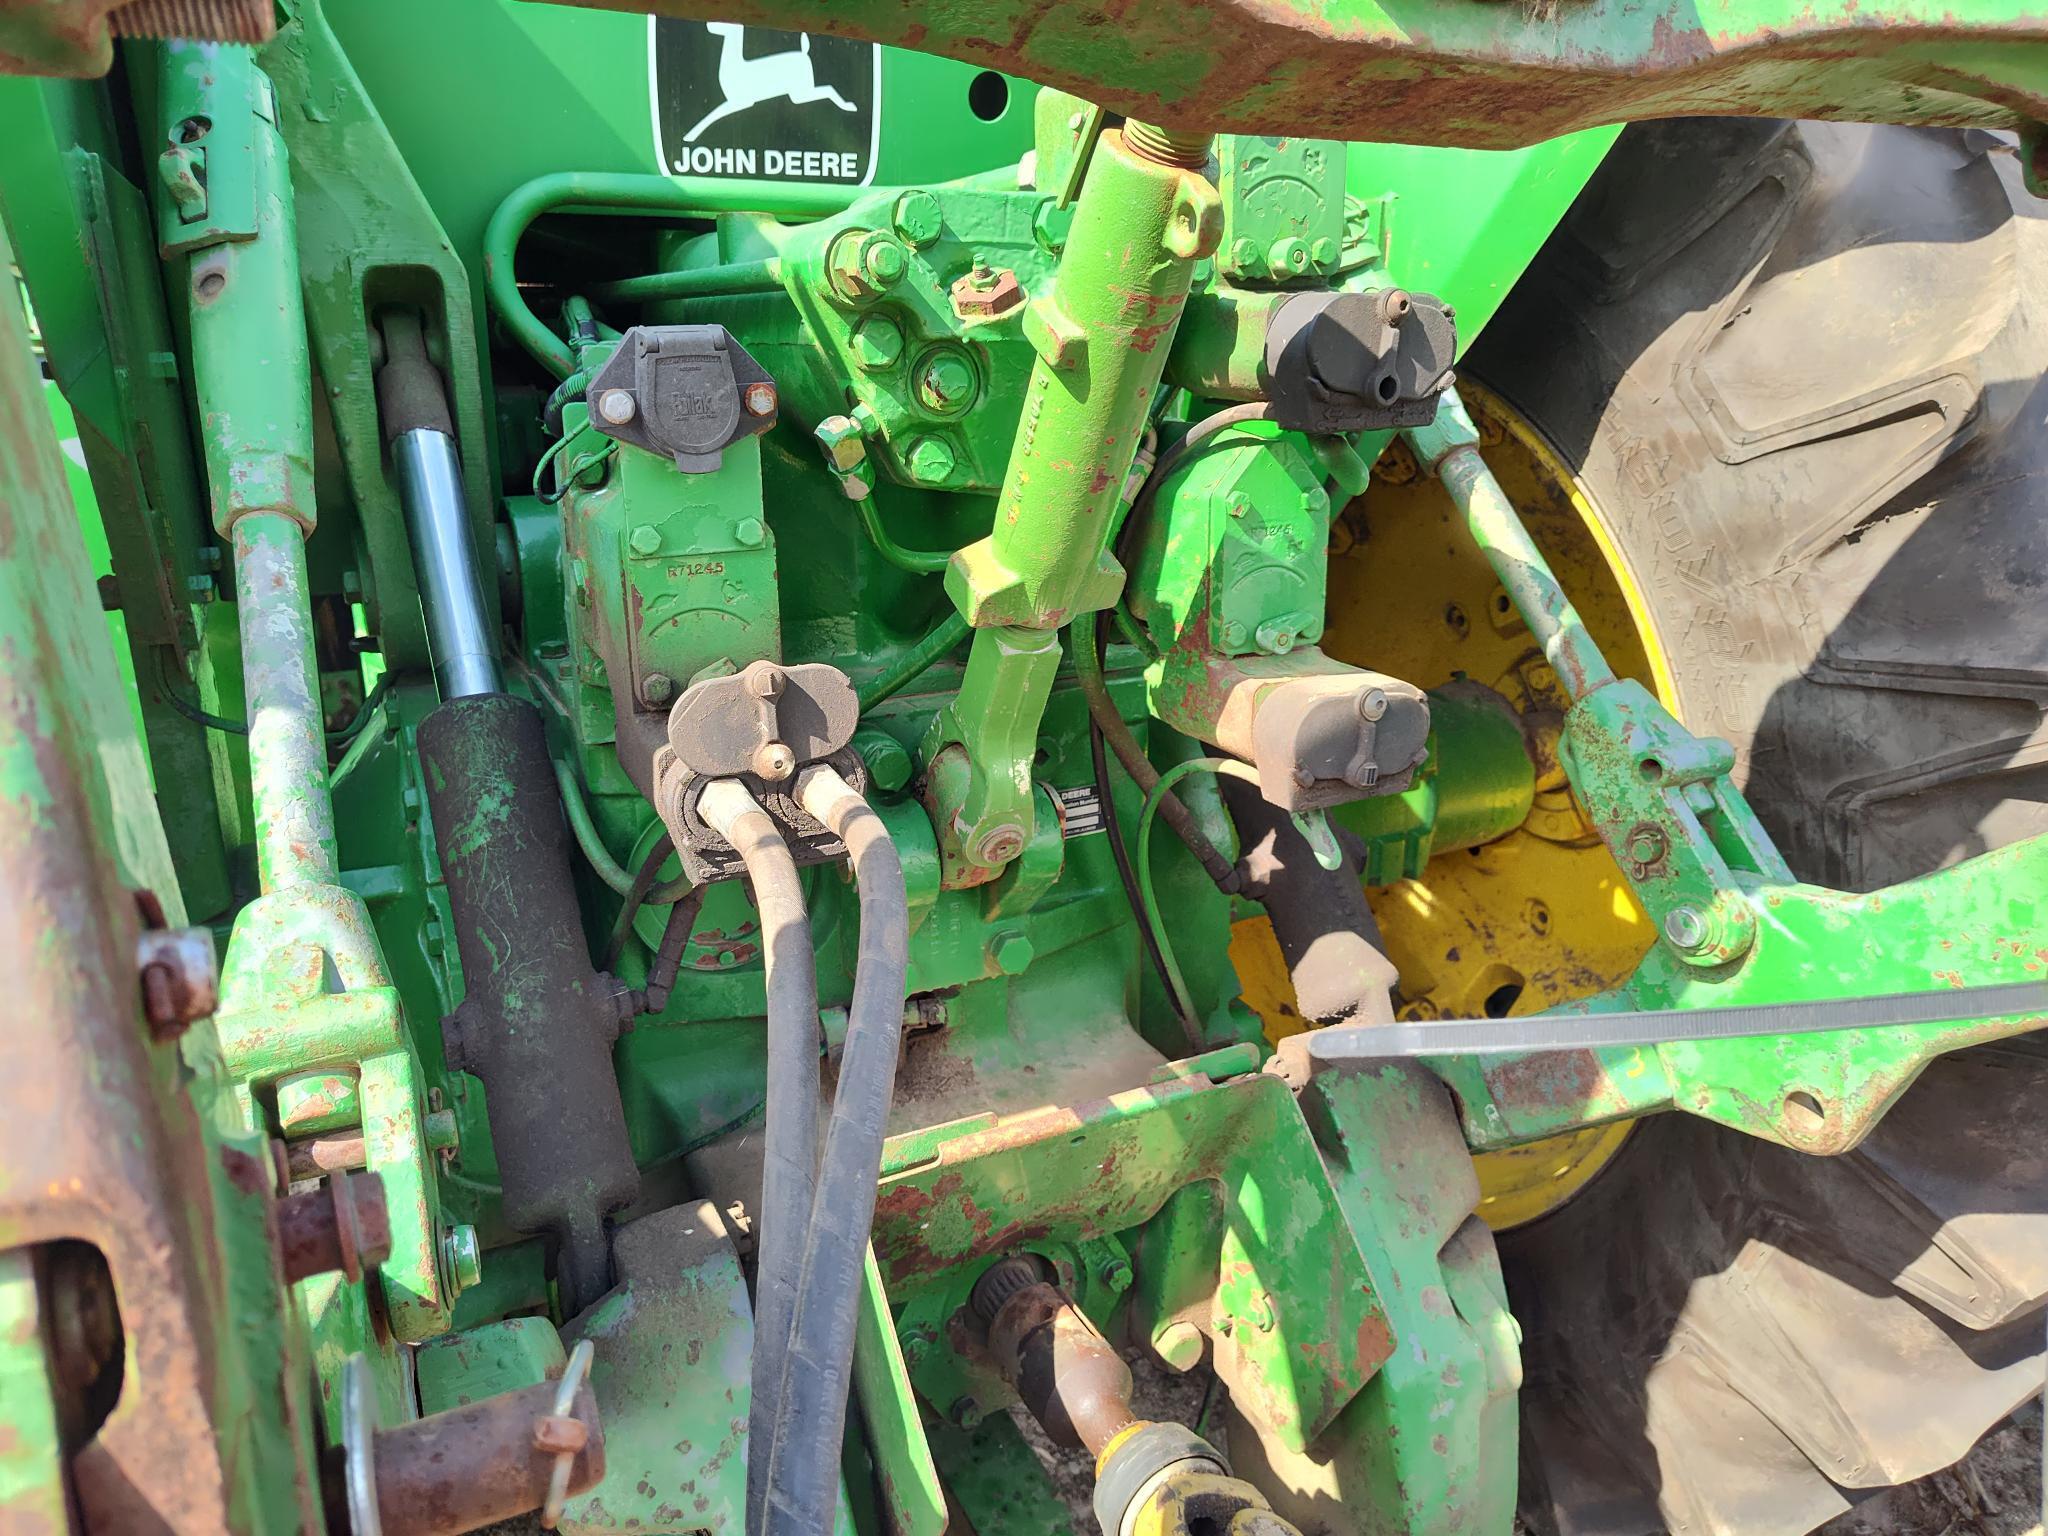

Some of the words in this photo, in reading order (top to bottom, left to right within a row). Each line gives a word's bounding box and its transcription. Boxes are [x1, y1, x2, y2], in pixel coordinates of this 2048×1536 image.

[673, 146, 757, 174] JOHN
[764, 150, 858, 178] DEERE
[667, 561, 724, 578] R71245
[1061, 788, 1091, 800] DEERE
